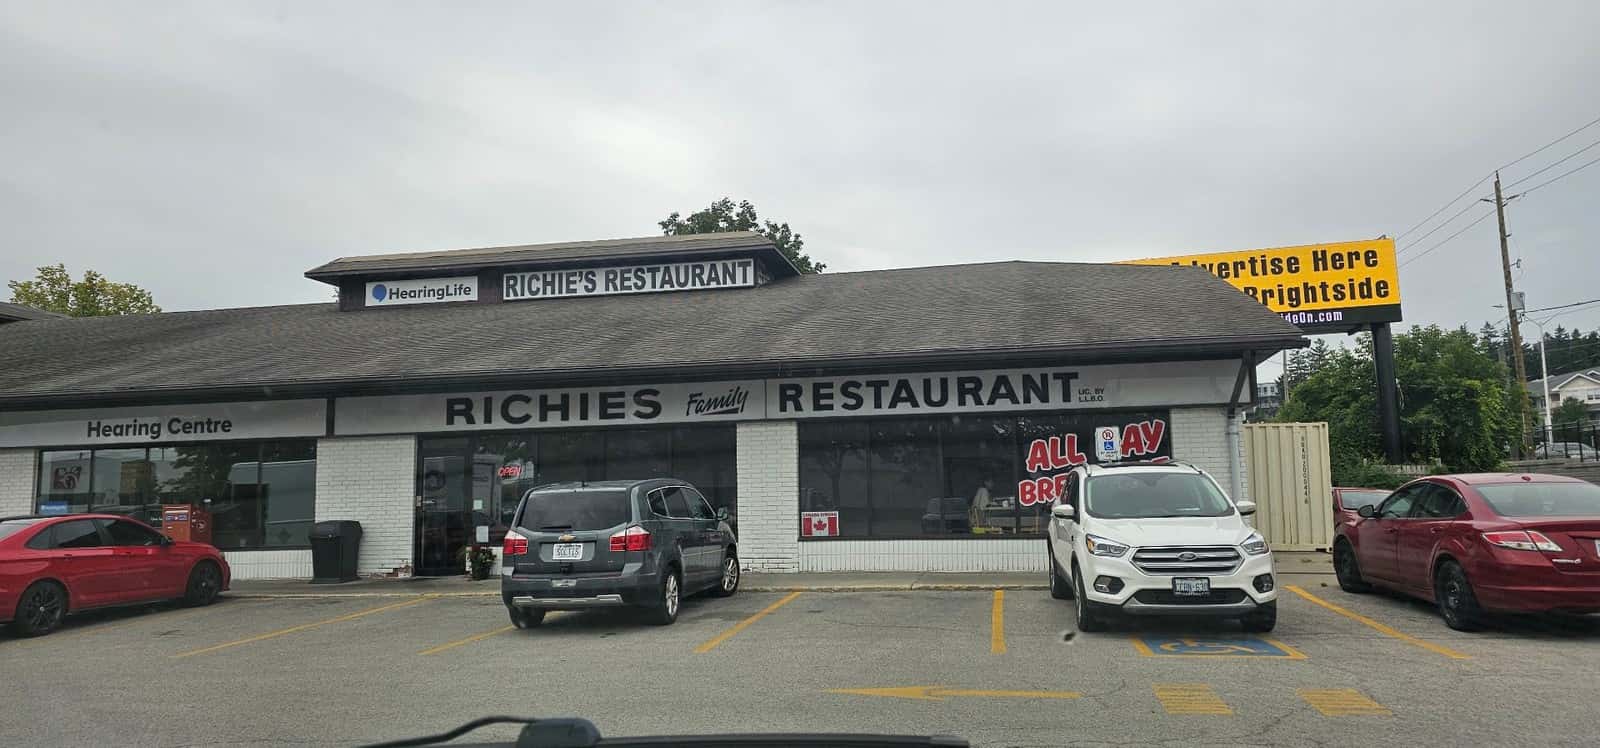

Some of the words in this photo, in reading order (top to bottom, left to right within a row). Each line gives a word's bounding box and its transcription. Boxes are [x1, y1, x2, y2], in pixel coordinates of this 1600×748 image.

[1171, 254, 1300, 279] vertise
[1312, 249, 1378, 272] Here
[388, 283, 472, 302] HearingLife
[505, 270, 597, 298] RICHIE'S
[605, 261, 751, 292] RESTAURANT
[446, 388, 662, 425] RICHIES
[686, 385, 749, 416] Family
[778, 372, 1080, 413] RESTAURANT
[87, 417, 161, 441] Hearing
[167, 416, 233, 436] Centre
[1026, 433, 1087, 472] ALL
[1120, 419, 1166, 457] AY
[498, 466, 521, 477] OPEN
